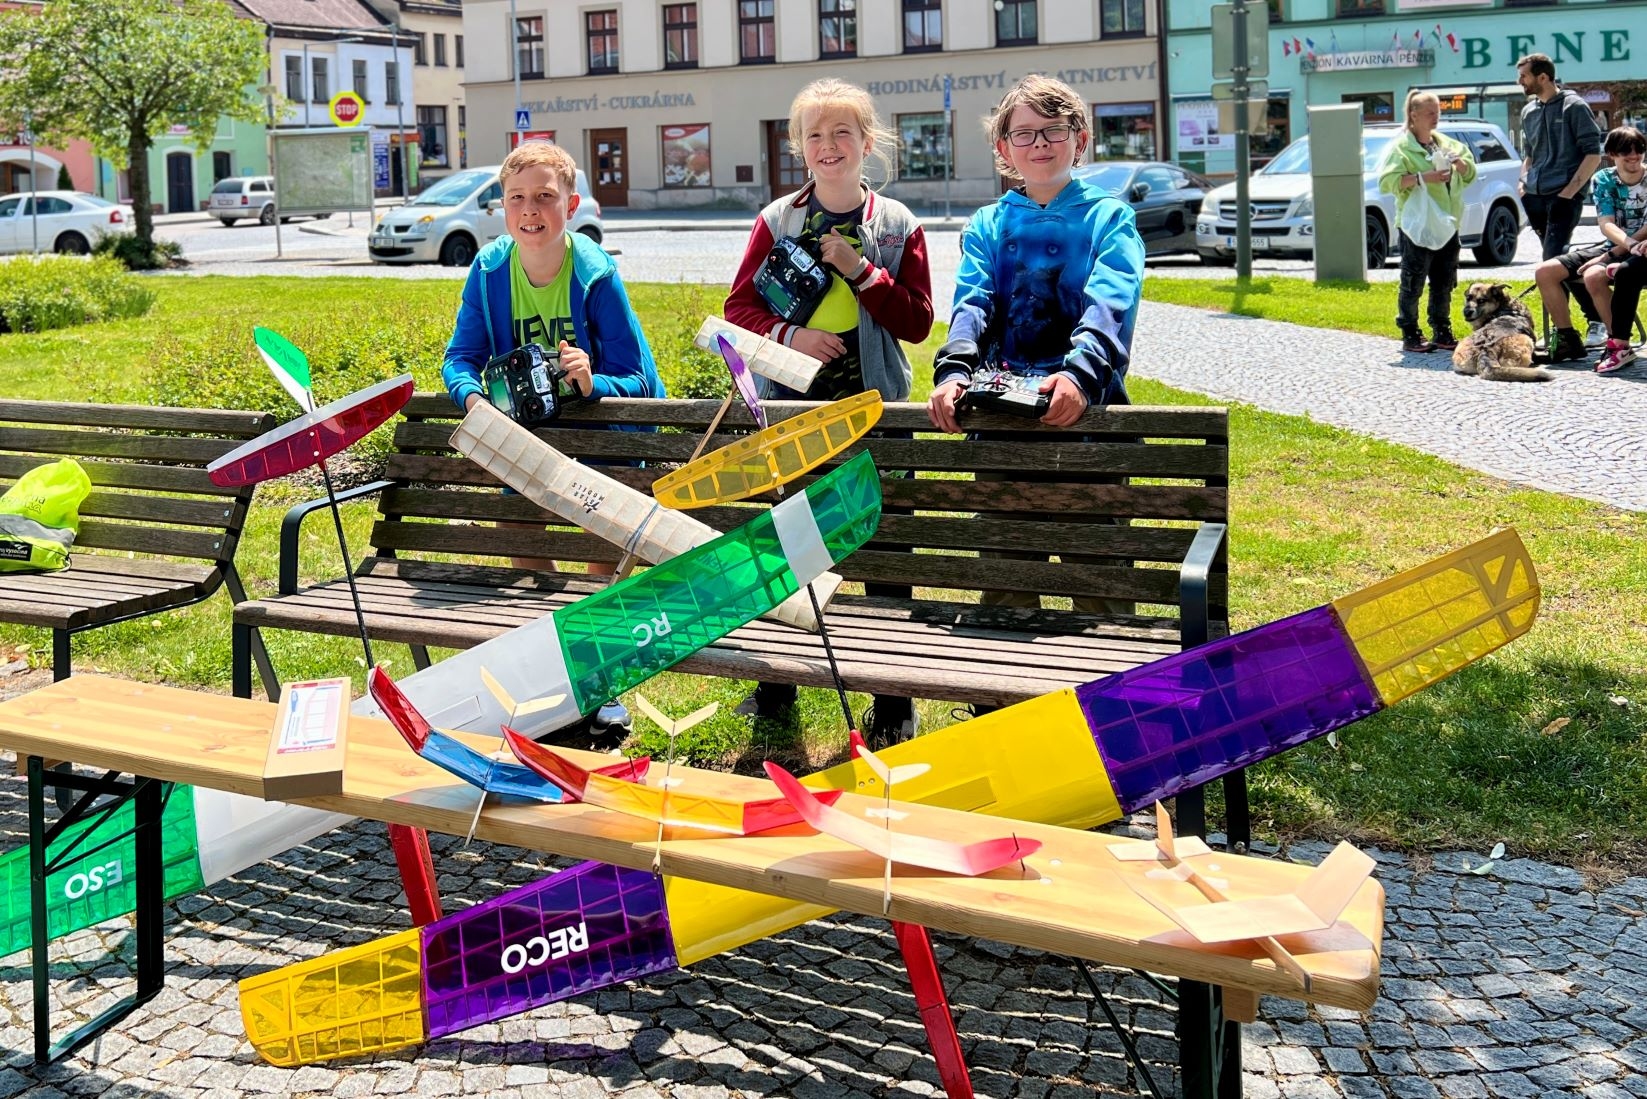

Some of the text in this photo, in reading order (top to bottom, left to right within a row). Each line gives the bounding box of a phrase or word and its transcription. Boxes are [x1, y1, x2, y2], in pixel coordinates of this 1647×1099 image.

[1461, 29, 1630, 69] BENE
[1027, 60, 1157, 84] ATNICTVÍ
[336, 103, 357, 116] STOP
[608, 90, 696, 110] CUKRÁRNA
[632, 611, 672, 647] RC
[64, 858, 123, 899] ESO
[500, 921, 590, 974] RECO
